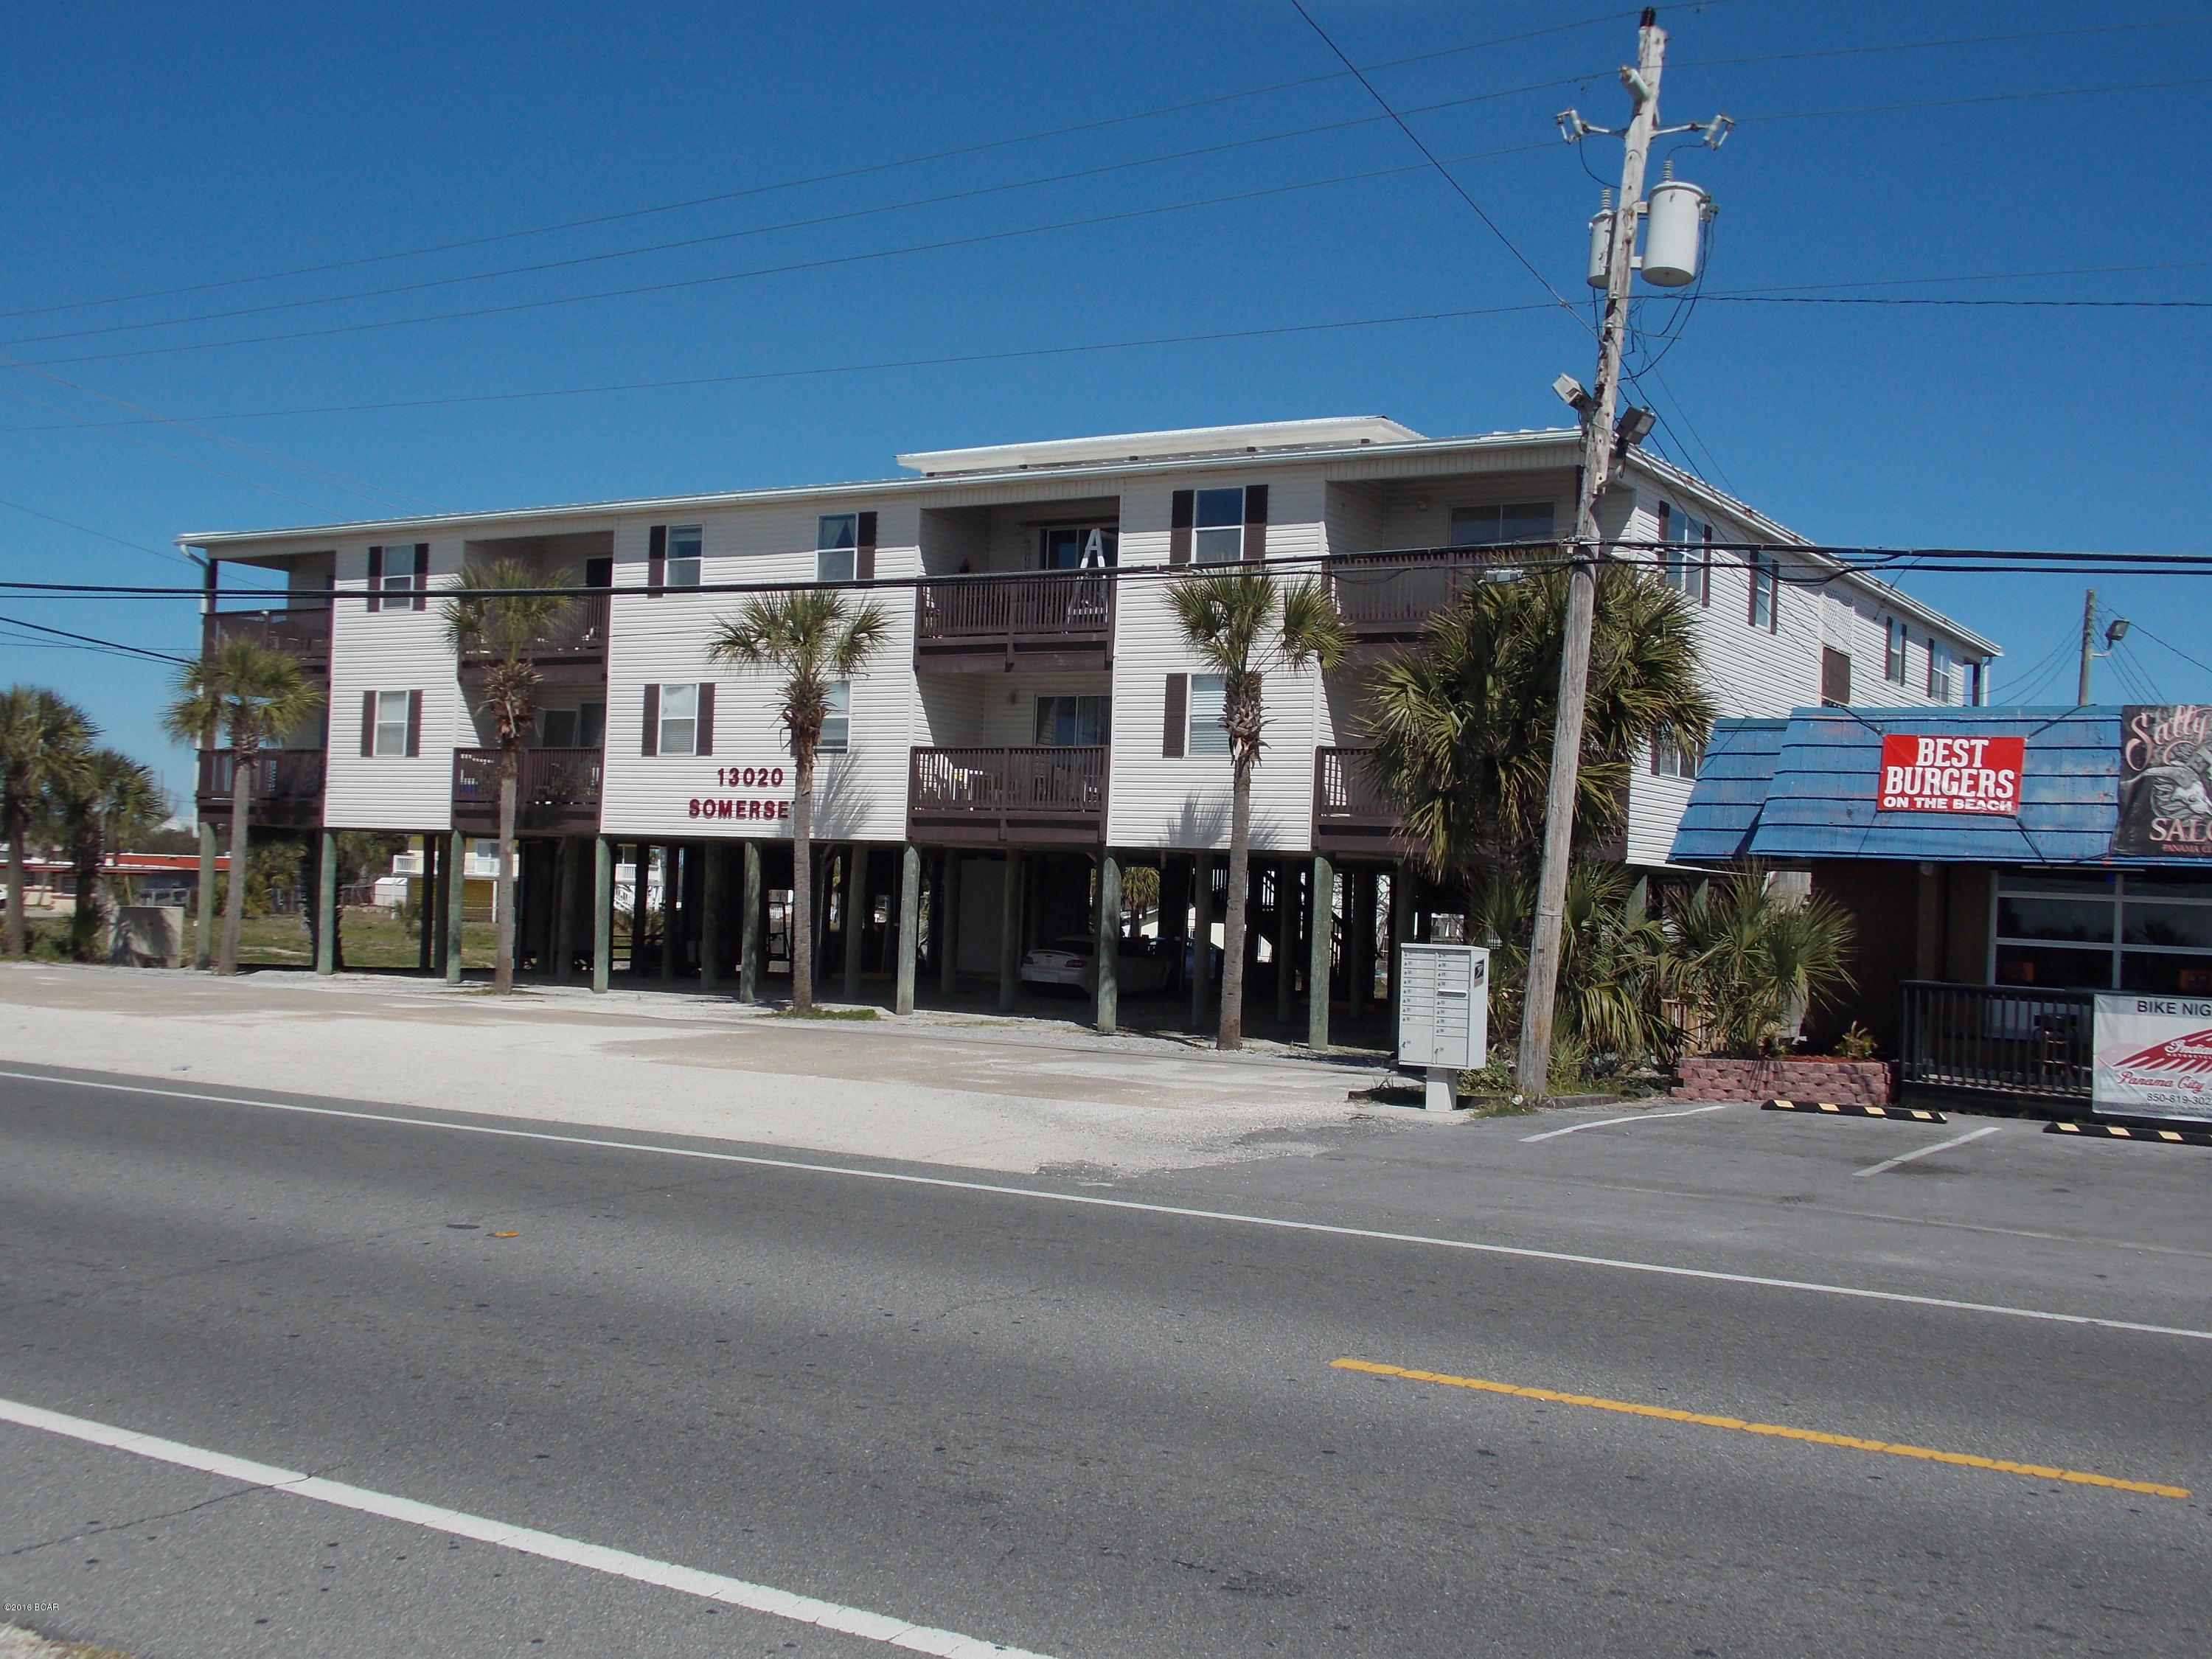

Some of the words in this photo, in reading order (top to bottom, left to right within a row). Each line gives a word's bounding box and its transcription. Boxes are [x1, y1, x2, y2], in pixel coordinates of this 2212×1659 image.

[1916, 738, 1989, 768] BEST
[717, 768, 783, 787] 13020
[1885, 766, 2015, 799] BURGERS
[689, 799, 795, 820] SOMERSE
[1883, 796, 1910, 808] ON
[1913, 797, 1948, 809] THE
[1952, 799, 2012, 812] BEACH
[2137, 1000, 2177, 1015] BIKE
[2118, 1071, 2174, 1088] Panama
[2177, 1076, 2205, 1093] City
[2146, 1093, 2212, 1105] 850-819-302
